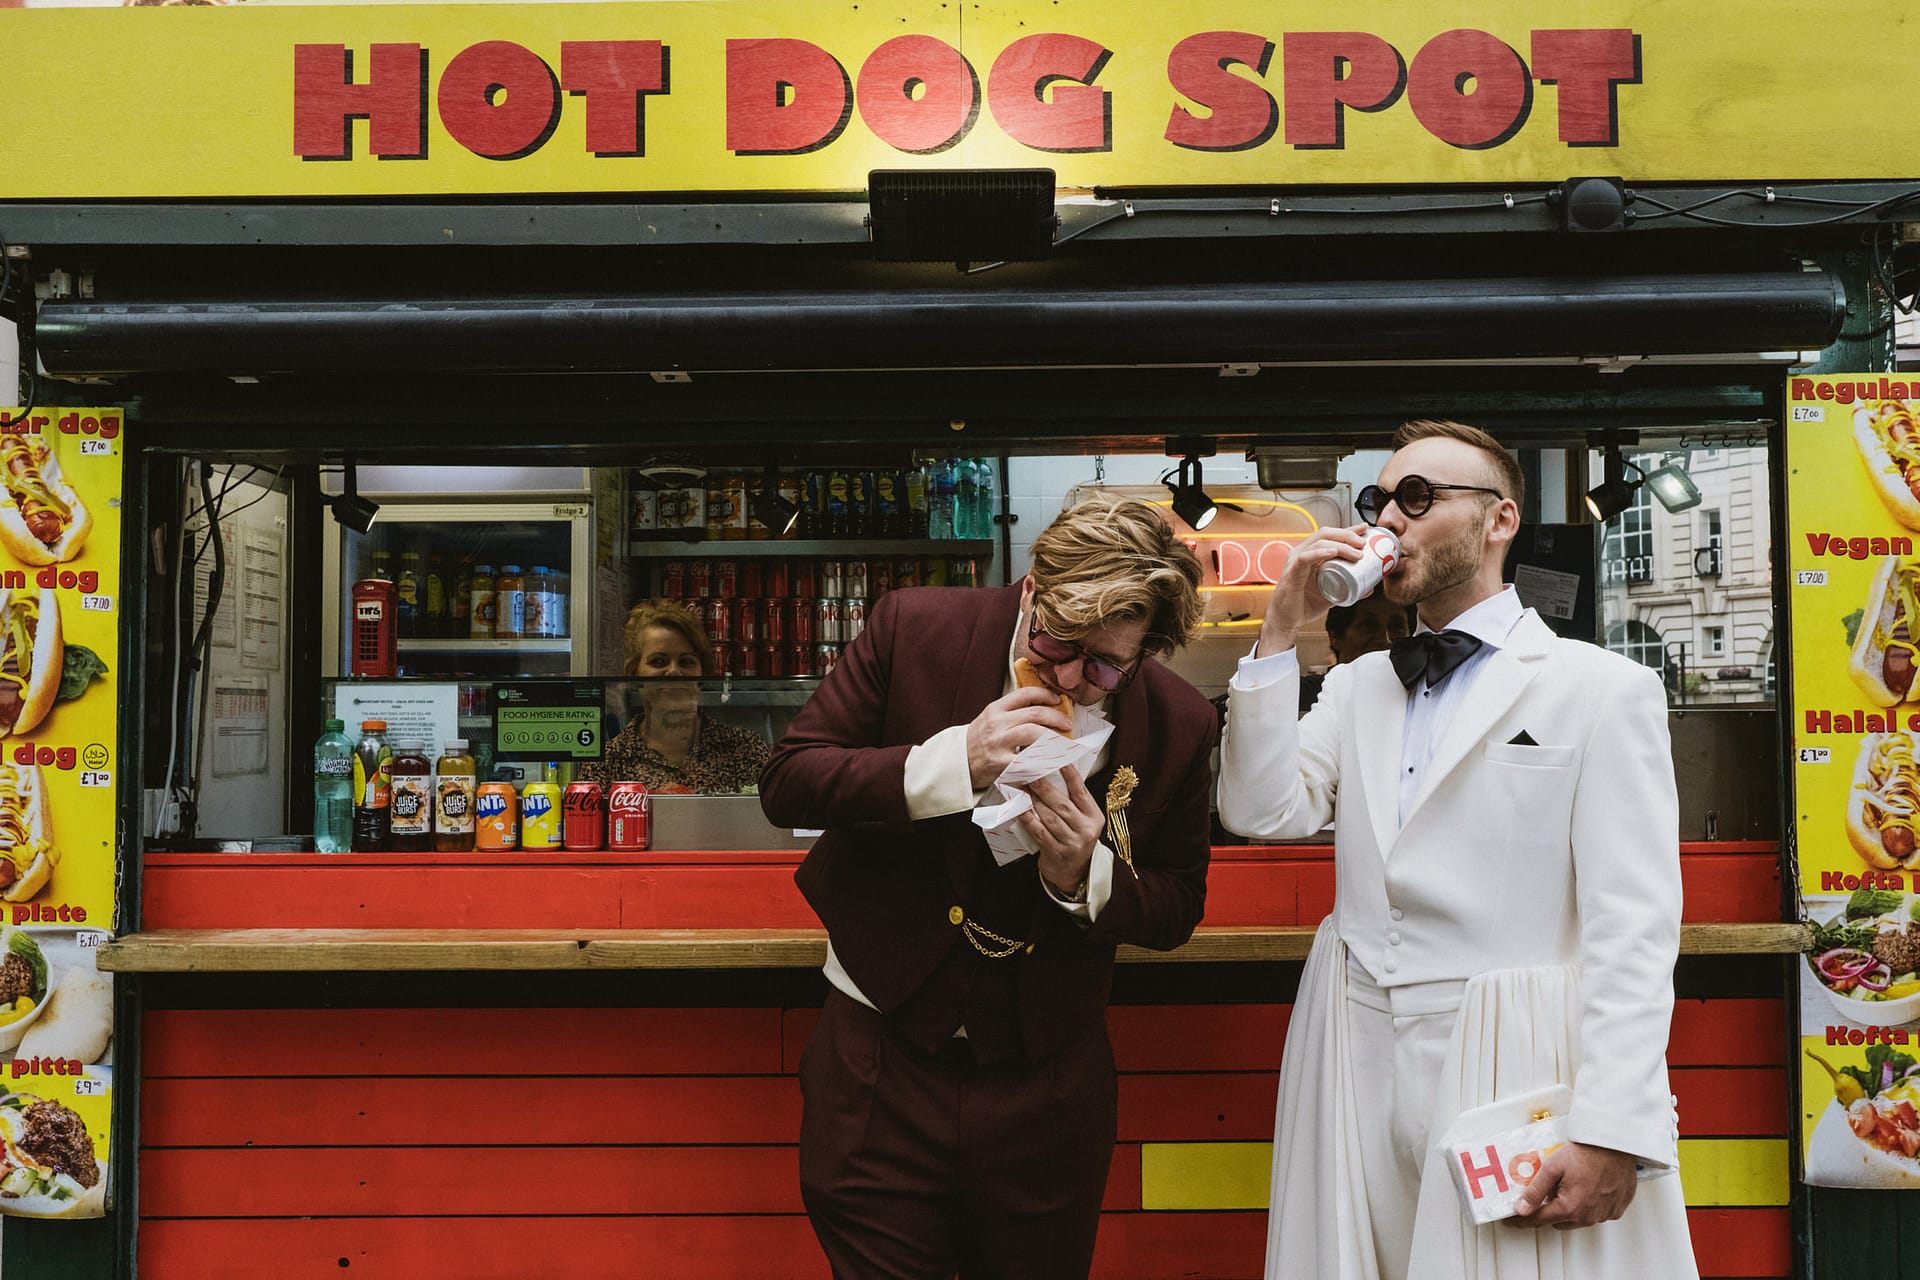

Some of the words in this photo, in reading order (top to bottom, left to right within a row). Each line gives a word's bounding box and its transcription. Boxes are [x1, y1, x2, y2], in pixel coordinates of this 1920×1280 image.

[294, 40, 670, 160] HOT
[726, 32, 1113, 155] DOG
[1165, 27, 1642, 150] SPOT
[58, 413, 120, 438] dog
[555, 507, 577, 516] Fridge
[1806, 533, 1912, 560] Vegan
[1218, 540, 1294, 585] DO
[36, 567, 99, 593] dog
[503, 711, 528, 719] FOOD
[530, 711, 564, 719] HYGIENE
[565, 711, 595, 719] RATING
[1805, 710, 1897, 733] Halal
[581, 731, 590, 744] 5
[14, 742, 77, 770] dog
[396, 796, 418, 807] JUICE
[398, 806, 417, 814] BURST
[443, 795, 466, 806] JUICE
[446, 806, 465, 814] BURST
[477, 794, 506, 811] ANTA
[1821, 871, 1904, 891] Kofta
[12, 903, 87, 925] plate
[1826, 1025, 1909, 1046] Kofta
[11, 1055, 83, 1079] pitta
